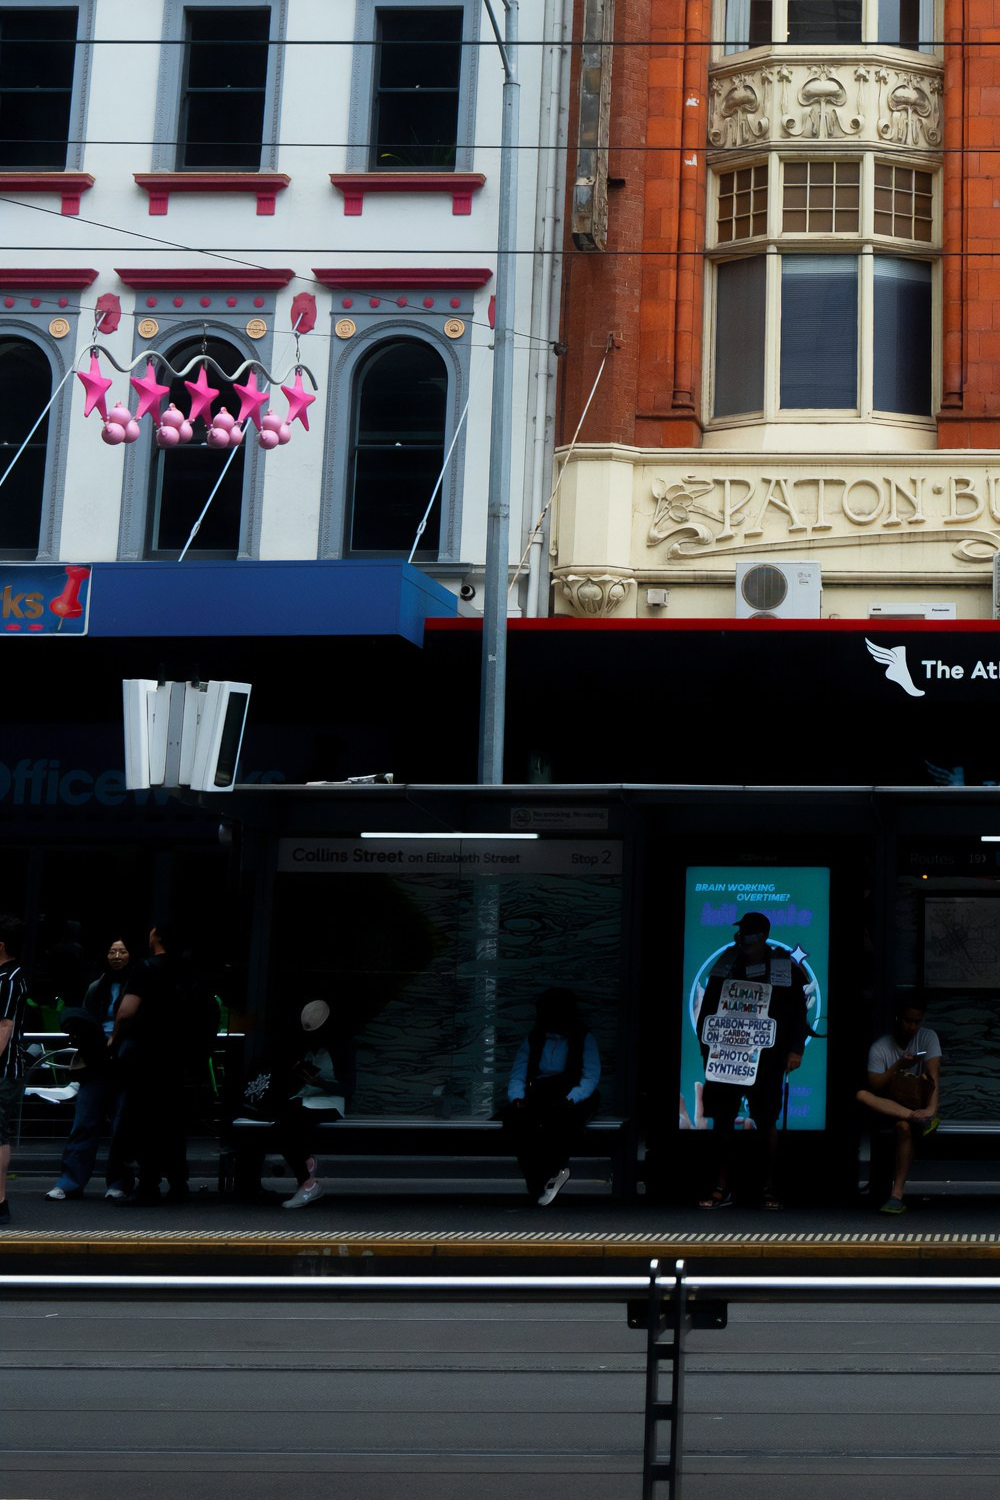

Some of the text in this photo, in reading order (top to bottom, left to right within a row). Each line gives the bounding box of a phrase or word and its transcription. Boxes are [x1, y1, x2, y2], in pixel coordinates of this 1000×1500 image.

[713, 476, 926, 541] PATON
[0, 585, 44, 619] ks
[921, 660, 964, 679] The
[292, 848, 520, 864] Collins Street on Elizabeth Street
[571, 850, 612, 866] Stop 2
[695, 883, 776, 892] BRAIN WORKING
[736, 893, 791, 902] OVERTIME?
[708, 1018, 772, 1031] CARBON-PRICE
[719, 1049, 749, 1062] PHOTO
[707, 1061, 756, 1077] SYNTHESIS
